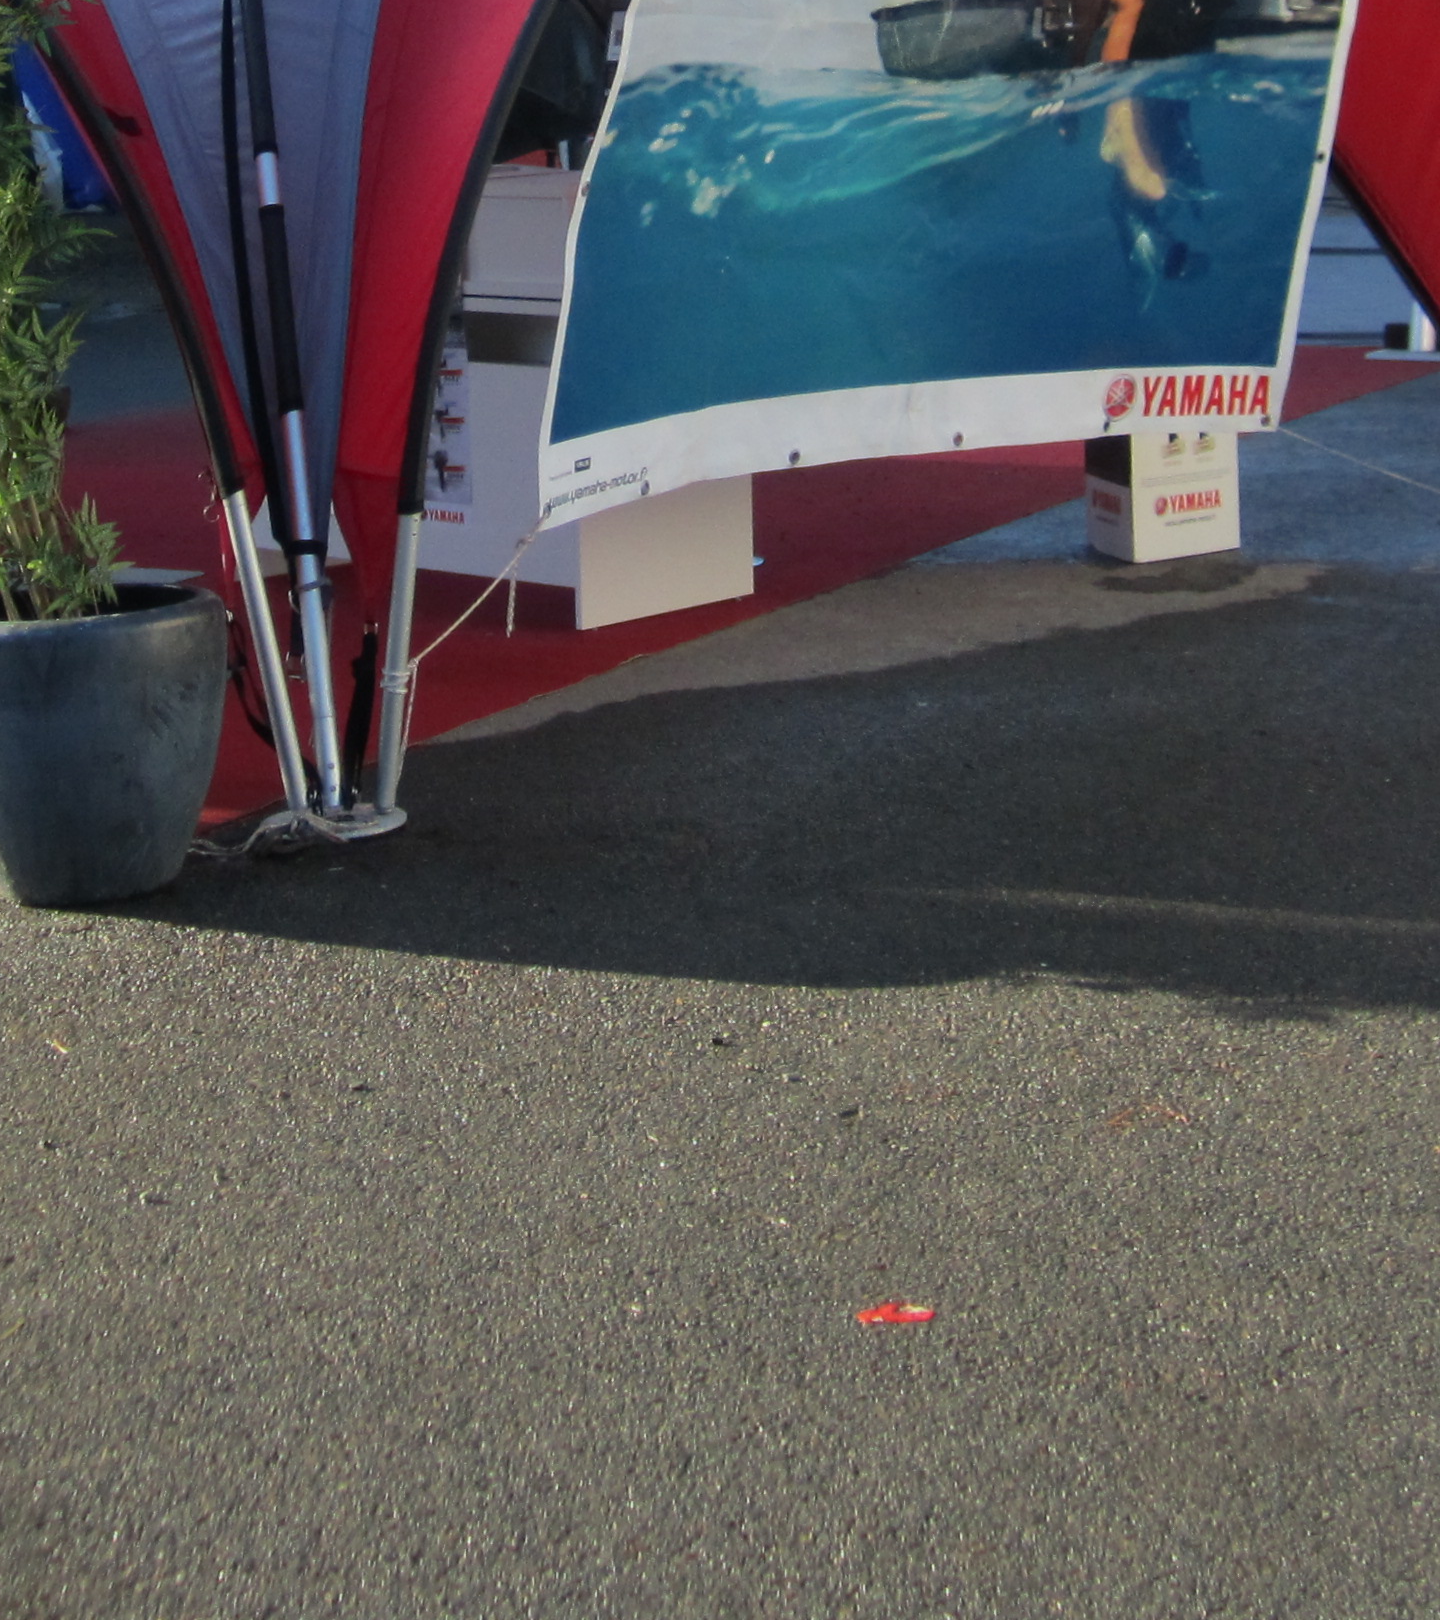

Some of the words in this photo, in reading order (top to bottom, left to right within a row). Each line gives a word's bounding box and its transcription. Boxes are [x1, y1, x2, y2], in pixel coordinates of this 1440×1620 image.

[1142, 374, 1271, 417] YAMAHA
[1169, 490, 1222, 514] YAMAHA
[429, 509, 465, 525] YAMAHA
